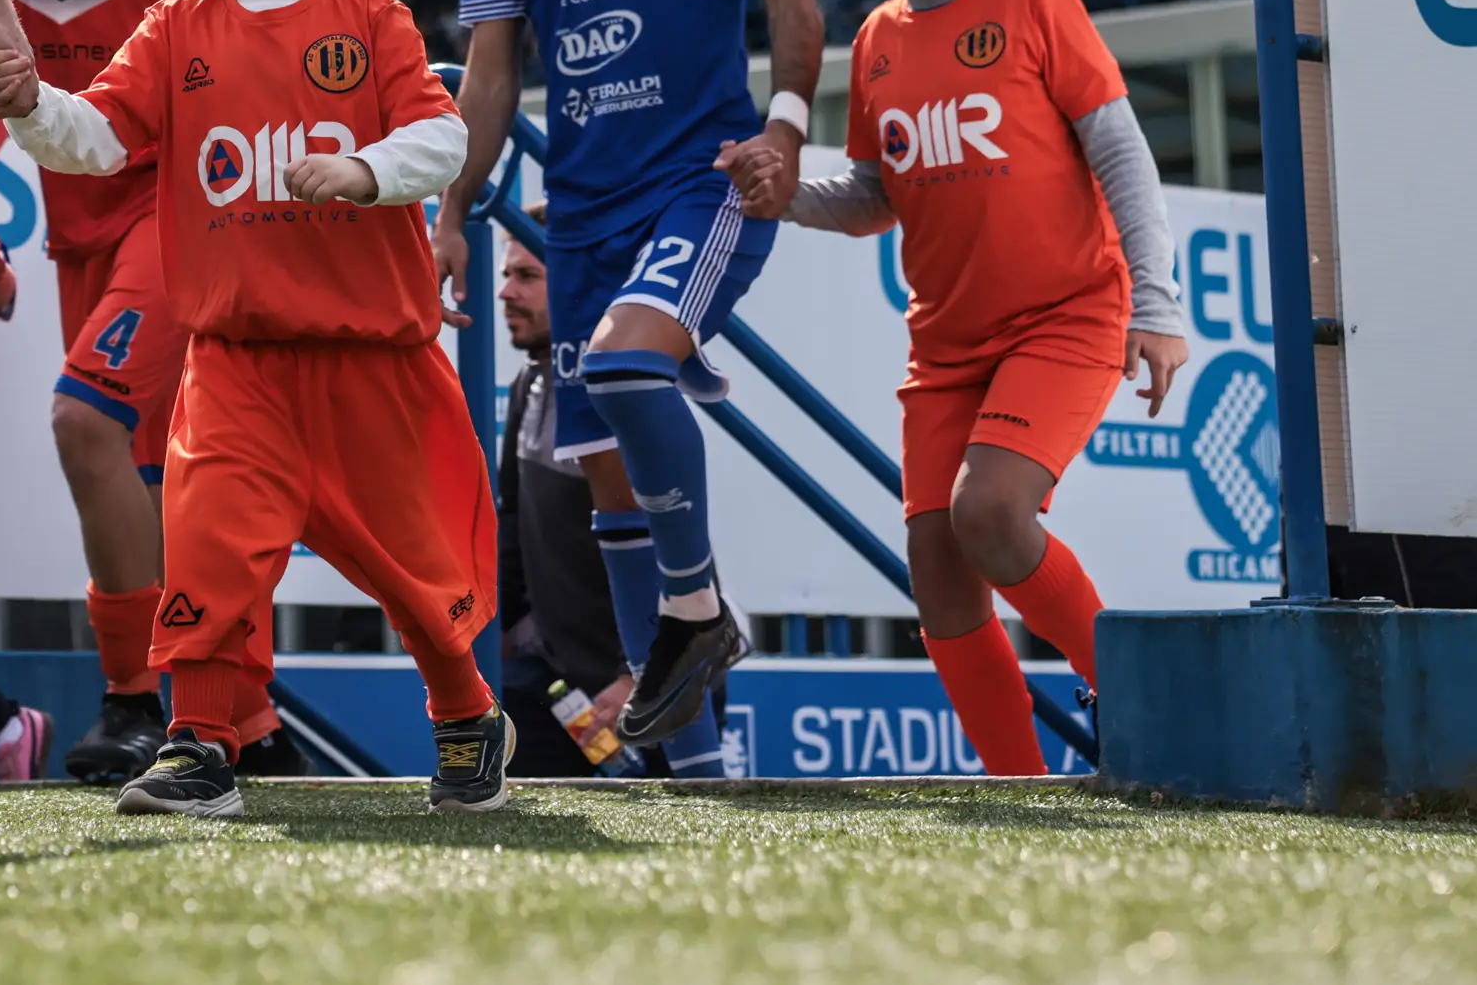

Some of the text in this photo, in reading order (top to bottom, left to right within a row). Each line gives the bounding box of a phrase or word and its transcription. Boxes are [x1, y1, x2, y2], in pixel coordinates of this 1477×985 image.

[560, 24, 627, 63] DAC
[587, 75, 662, 102] FERALPI
[208, 210, 359, 232] AUTOMOTIVE
[92, 307, 144, 370] 4
[1092, 428, 1180, 459] FILTRI
